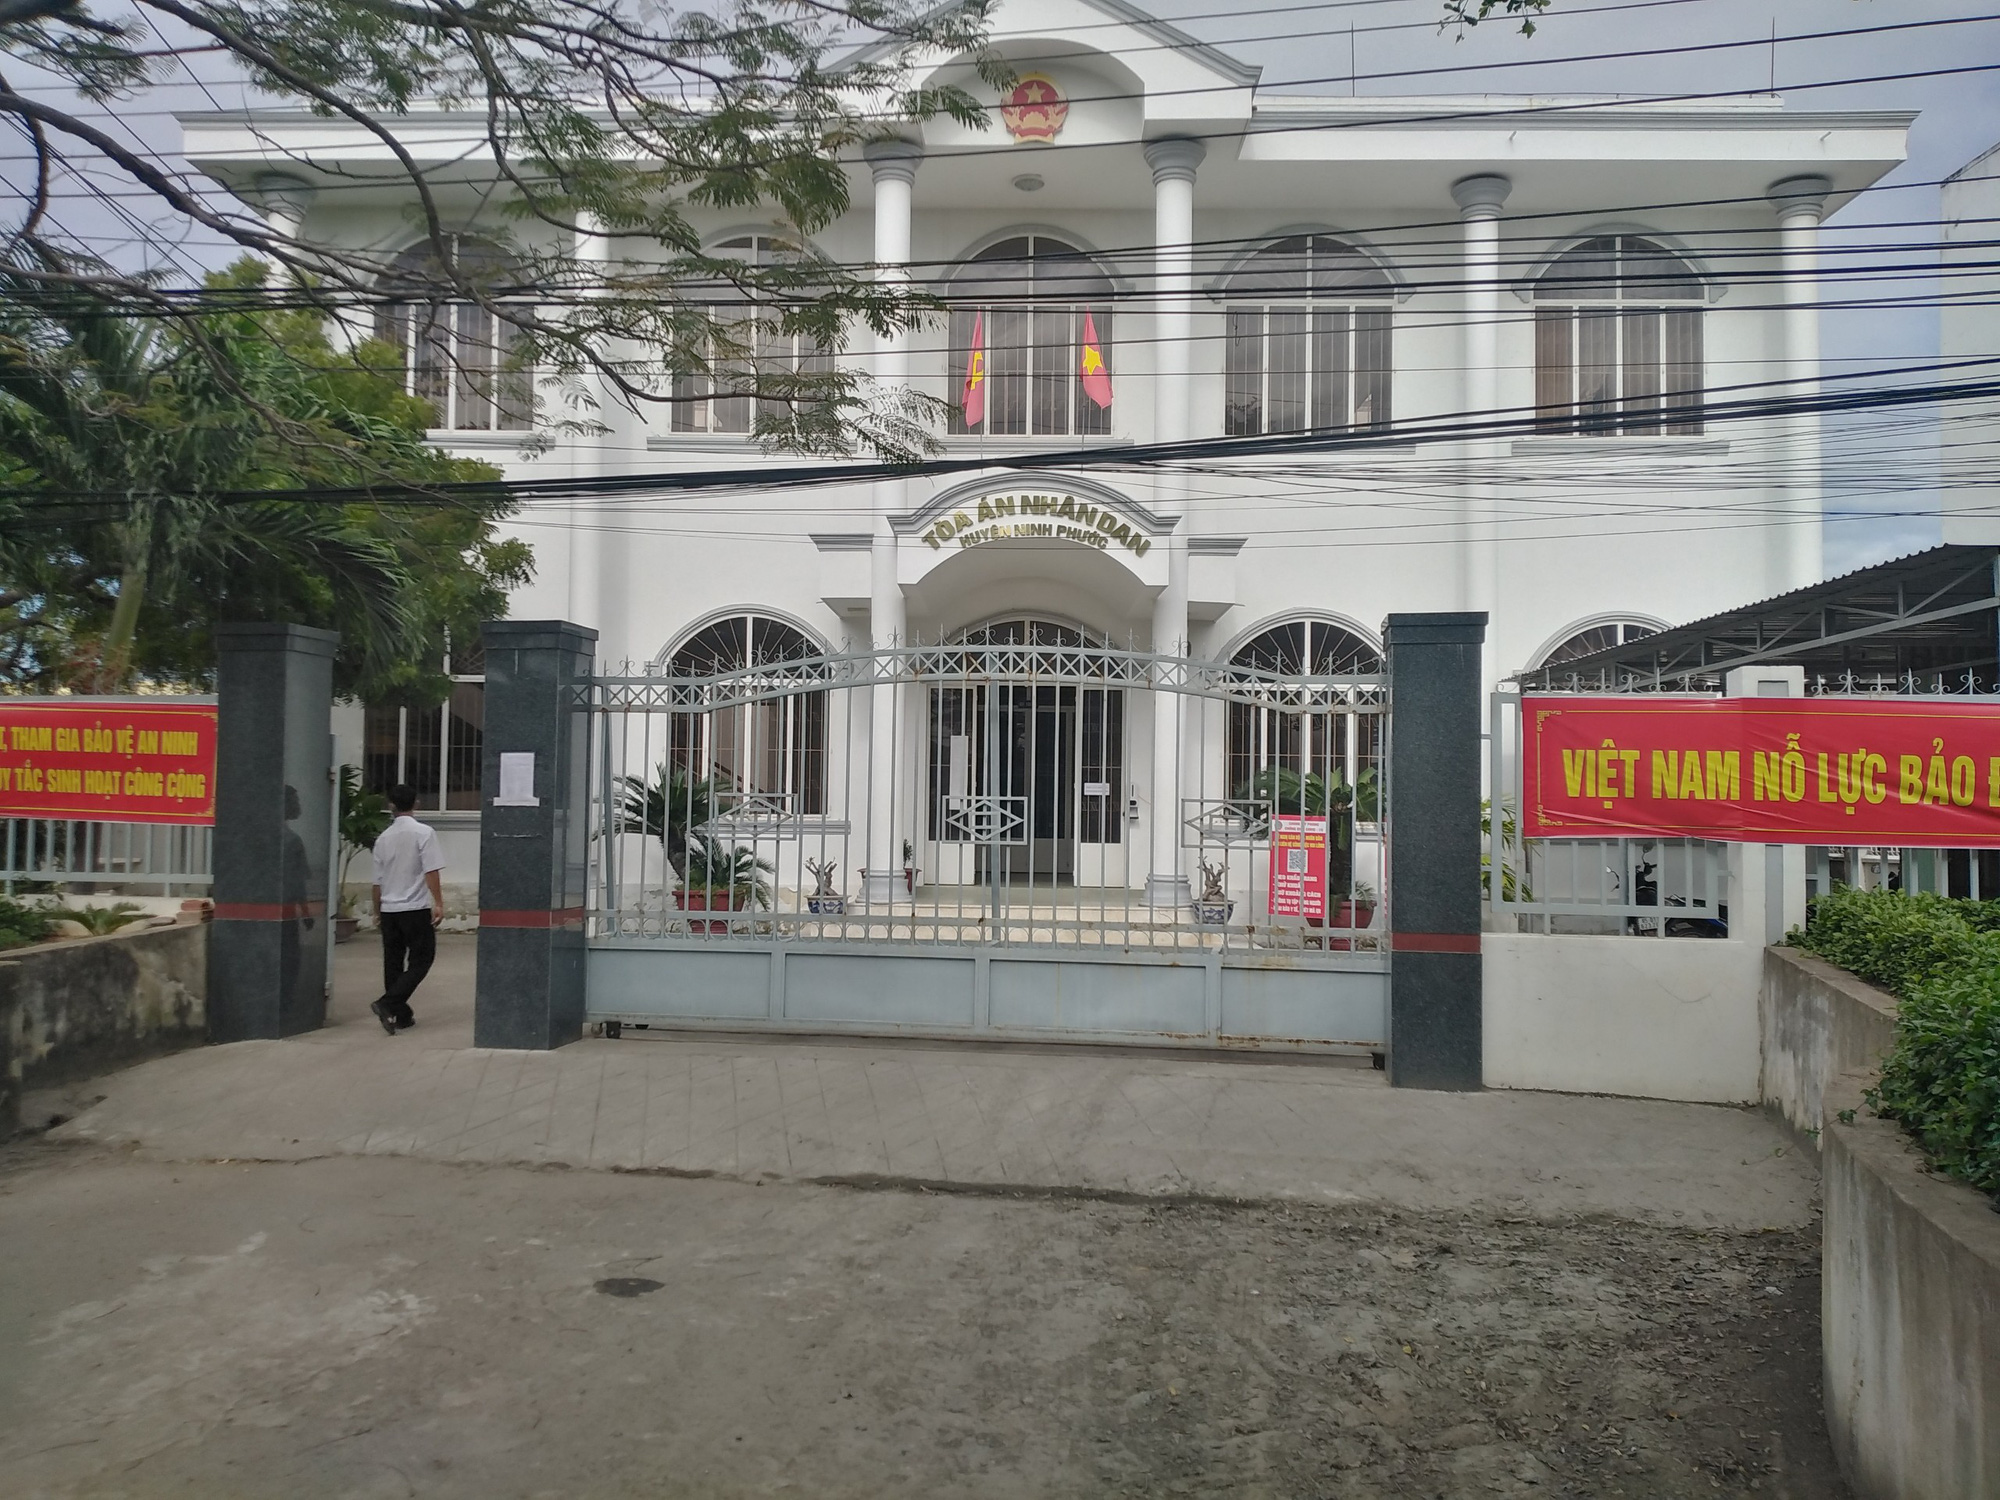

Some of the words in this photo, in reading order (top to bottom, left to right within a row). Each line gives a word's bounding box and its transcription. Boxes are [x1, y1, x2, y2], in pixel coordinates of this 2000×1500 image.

[977, 496, 1016, 522] ÁN
[1021, 495, 1098, 526] NHÂN
[1014, 523, 1053, 537] NINH
[10, 727, 52, 751] THAM
[56, 728, 80, 752] GIA
[83, 721, 113, 753] BẢO
[116, 725, 134, 759] VỆ
[137, 731, 159, 754] AN
[161, 731, 199, 756] NINH
[46, 769, 81, 793] SINH
[84, 770, 122, 800] HOẠT
[124, 767, 163, 796] CÔNG
[166, 768, 206, 803] CỘNG
[1562, 738, 1640, 809] VIỆT
[1652, 749, 1740, 801] NAM
[1754, 733, 1806, 803] NỖ
[1818, 748, 1887, 815] LỰC
[1900, 737, 1976, 806] BẢO
